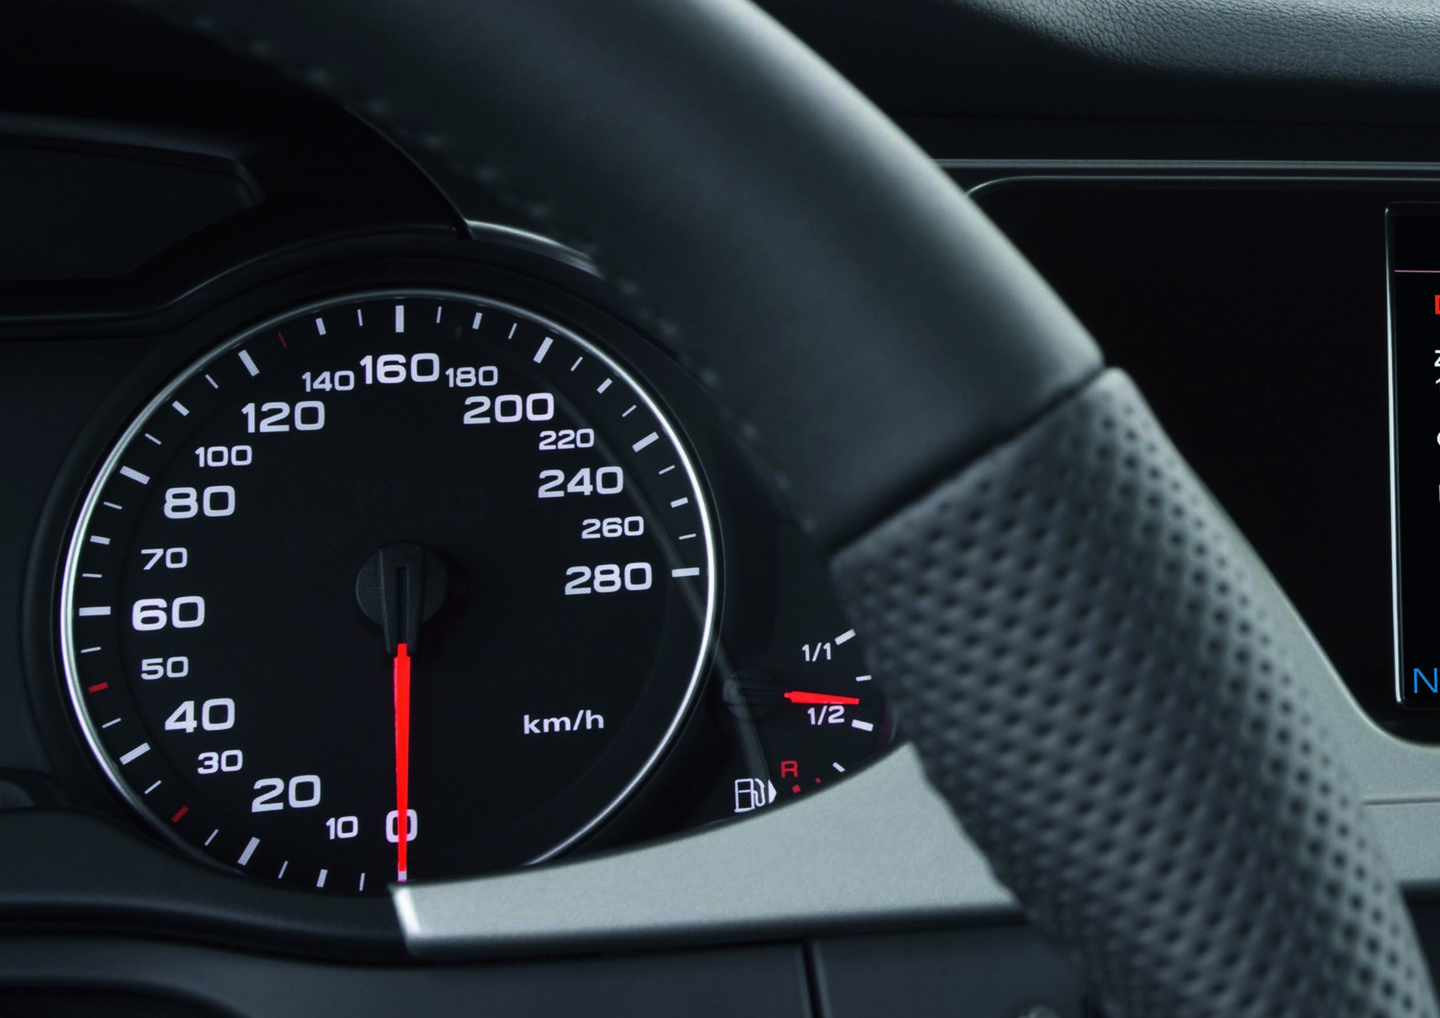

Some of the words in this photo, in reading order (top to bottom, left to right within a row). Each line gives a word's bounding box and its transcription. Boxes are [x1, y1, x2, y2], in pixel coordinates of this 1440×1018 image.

[301, 370, 355, 393] 140
[359, 352, 440, 385] 160
[444, 365, 499, 388] 180
[240, 400, 326, 434] 120
[463, 392, 555, 425] 200
[538, 427, 595, 451] 220
[194, 444, 253, 468] 100
[537, 465, 624, 499] 240
[163, 485, 236, 520] 80
[581, 515, 645, 539] 260
[140, 547, 188, 571] 70
[564, 561, 653, 596] 280
[131, 595, 206, 632] 60
[801, 642, 832, 662] 1/1
[140, 655, 189, 681] 50
[164, 697, 236, 734] 40
[523, 709, 605, 734] km/h
[806, 704, 846, 726] 1/2
[196, 749, 244, 775] 30
[779, 759, 799, 779] R
[251, 774, 322, 812] 20
[325, 815, 359, 840] 10
[384, 806, 419, 845] 0
